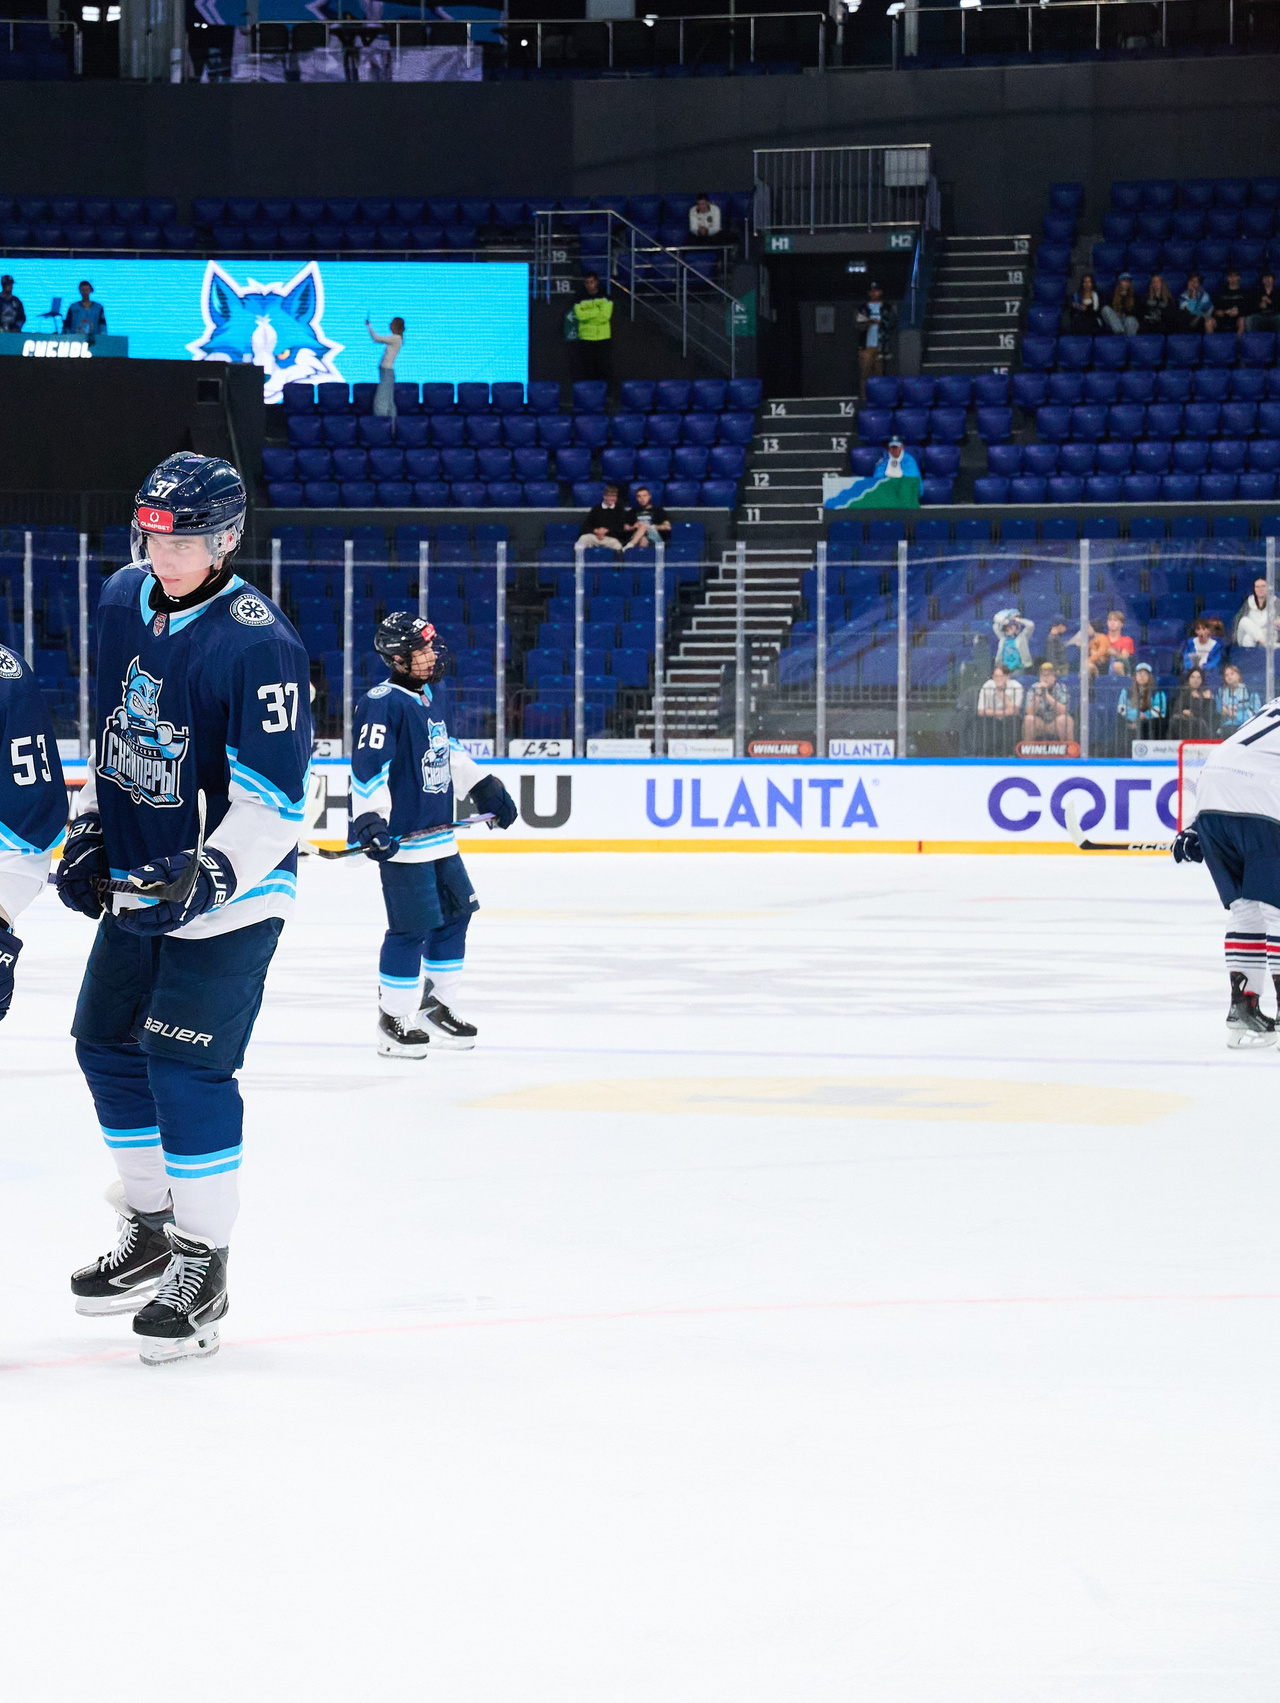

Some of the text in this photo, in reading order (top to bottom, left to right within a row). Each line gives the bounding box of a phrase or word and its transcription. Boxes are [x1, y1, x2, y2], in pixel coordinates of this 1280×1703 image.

[771, 237, 790, 250] H1
[891, 235, 912, 248] H2
[1014, 240, 1029, 253] 19
[1007, 271, 1023, 285] 18
[556, 281, 570, 293] 18
[1005, 301, 1020, 314] 17
[998, 334, 1015, 347] 16
[770, 403, 787, 416] 14
[839, 402, 855, 415] 14
[763, 438, 779, 451] 13
[831, 437, 847, 450] 13
[753, 473, 770, 487] 12
[147, 480, 177, 499] 37
[746, 508, 761, 522] 11
[140, 521, 171, 531] OLIMPBET
[257, 682, 300, 734] 37
[357, 723, 387, 750] 26
[752, 744, 799, 756] WINLINE
[831, 742, 892, 757] ULANTA
[1020, 744, 1066, 756] WINLINE
[10, 733, 52, 787] 53
[646, 776, 880, 830] ULANTA
[987, 776, 1196, 832] СОГ
[143, 1016, 214, 1048] BAUER
